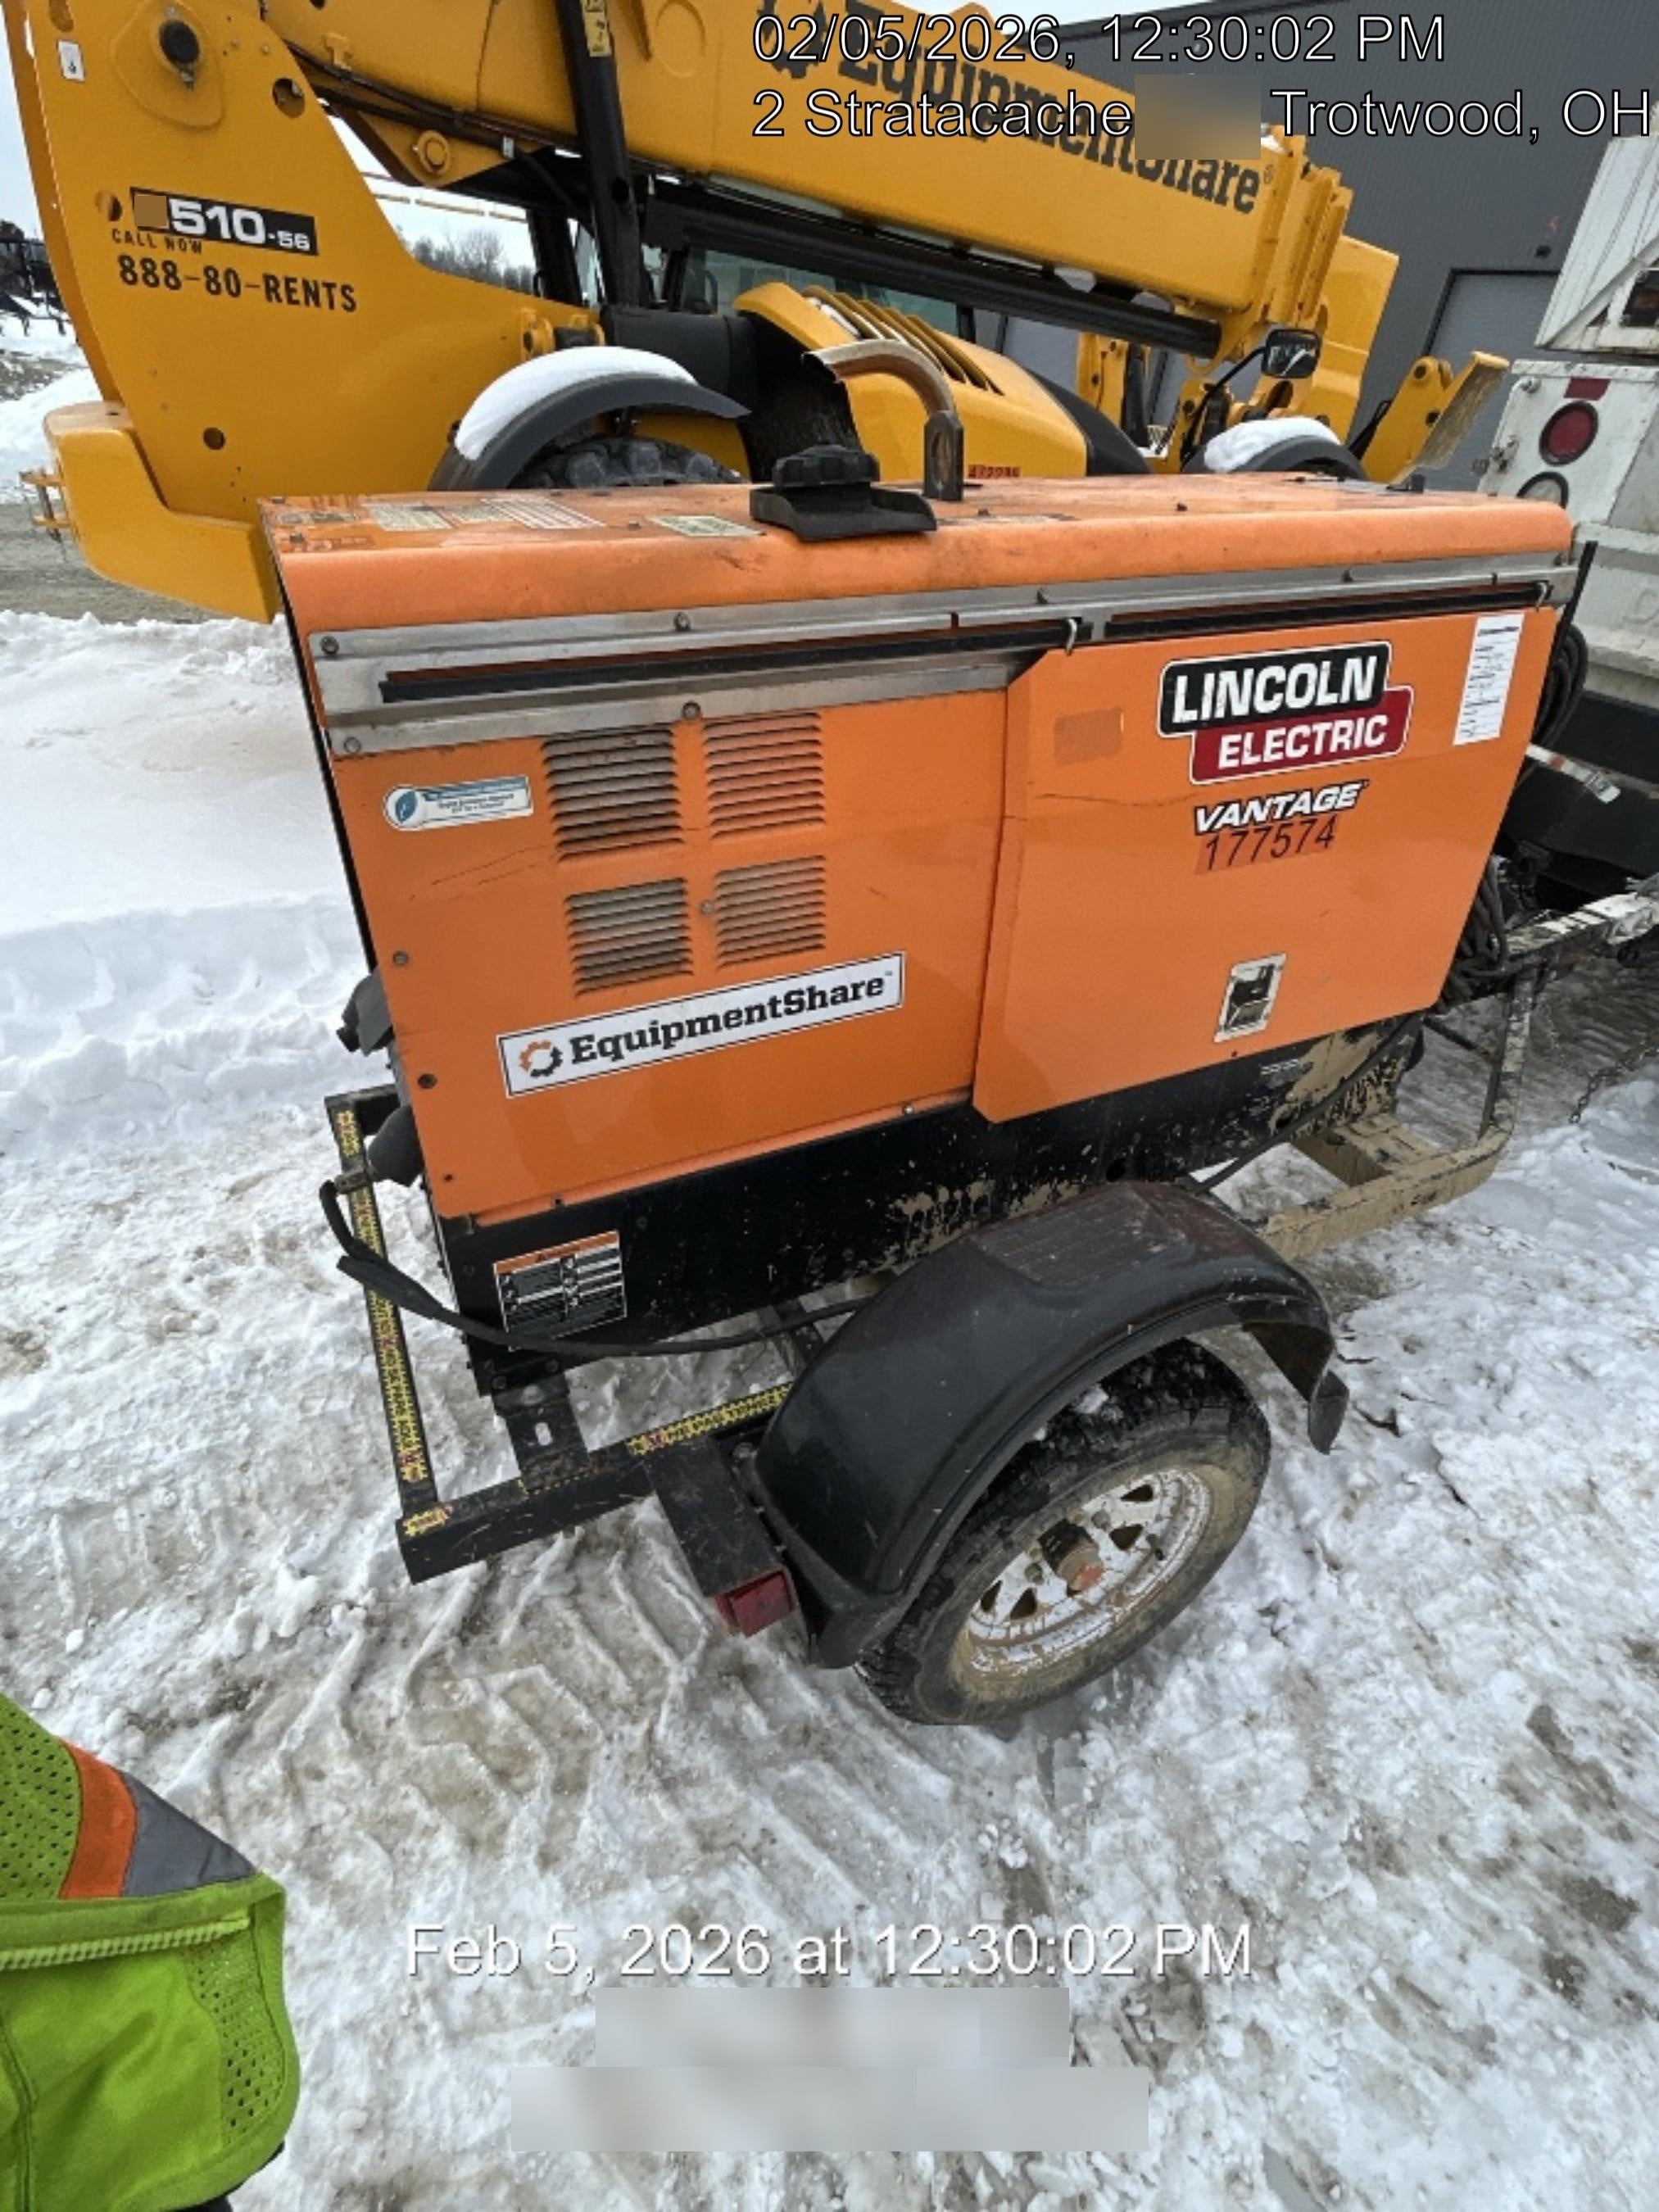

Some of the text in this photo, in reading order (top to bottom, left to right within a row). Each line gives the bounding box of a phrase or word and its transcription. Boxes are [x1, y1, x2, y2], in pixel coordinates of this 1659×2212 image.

[111, 228, 202, 255] CALL NOW
[117, 254, 358, 313] 888-80-RENTS
[1172, 655, 1378, 723] LINCOLN
[1217, 714, 1388, 770] ELECTRIC
[1194, 782, 1363, 835] VANTAGE
[1206, 814, 1339, 871] 177574
[569, 976, 885, 1065] EquipmentShare
